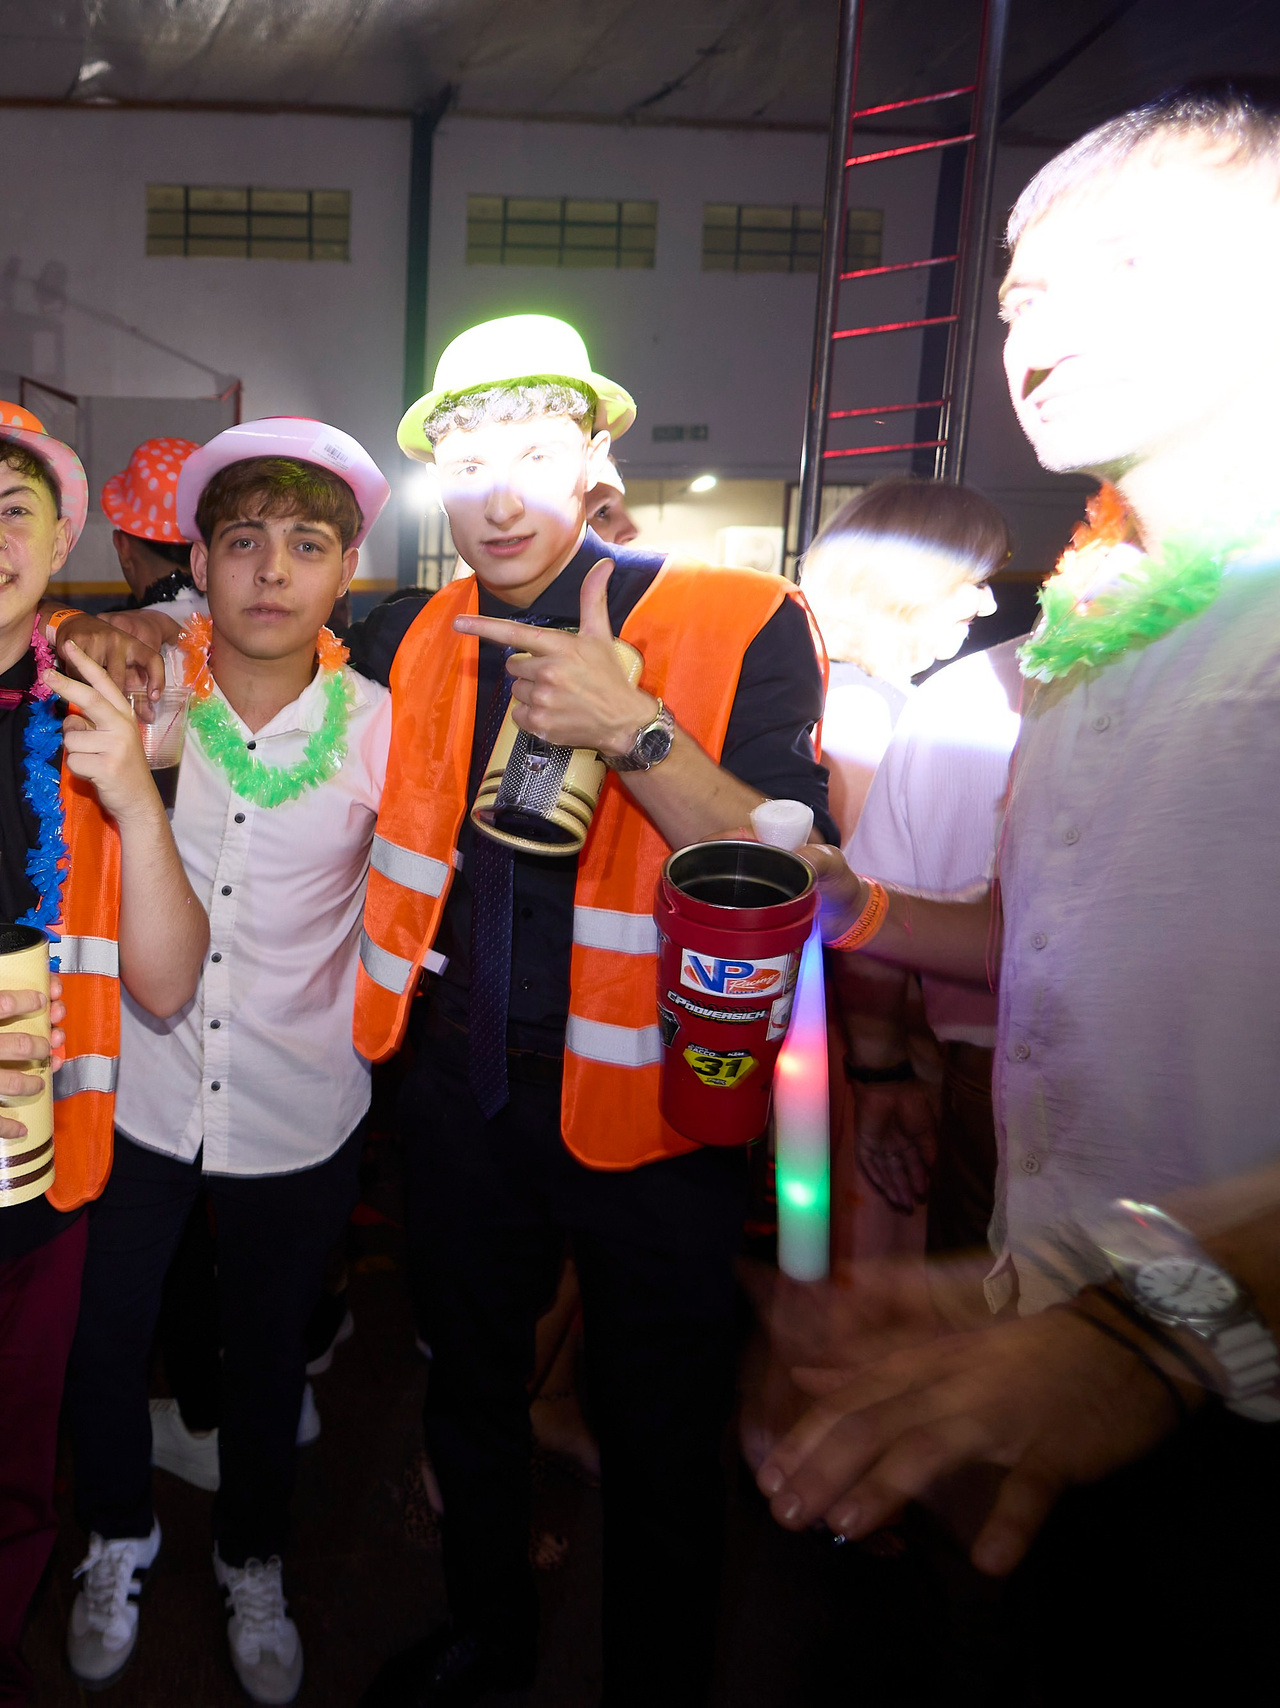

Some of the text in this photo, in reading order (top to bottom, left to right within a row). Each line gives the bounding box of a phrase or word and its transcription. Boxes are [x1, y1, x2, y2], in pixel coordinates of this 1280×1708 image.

[687, 955, 754, 993] VP
[728, 973, 780, 990] Racing
[692, 1056, 742, 1078] 31
